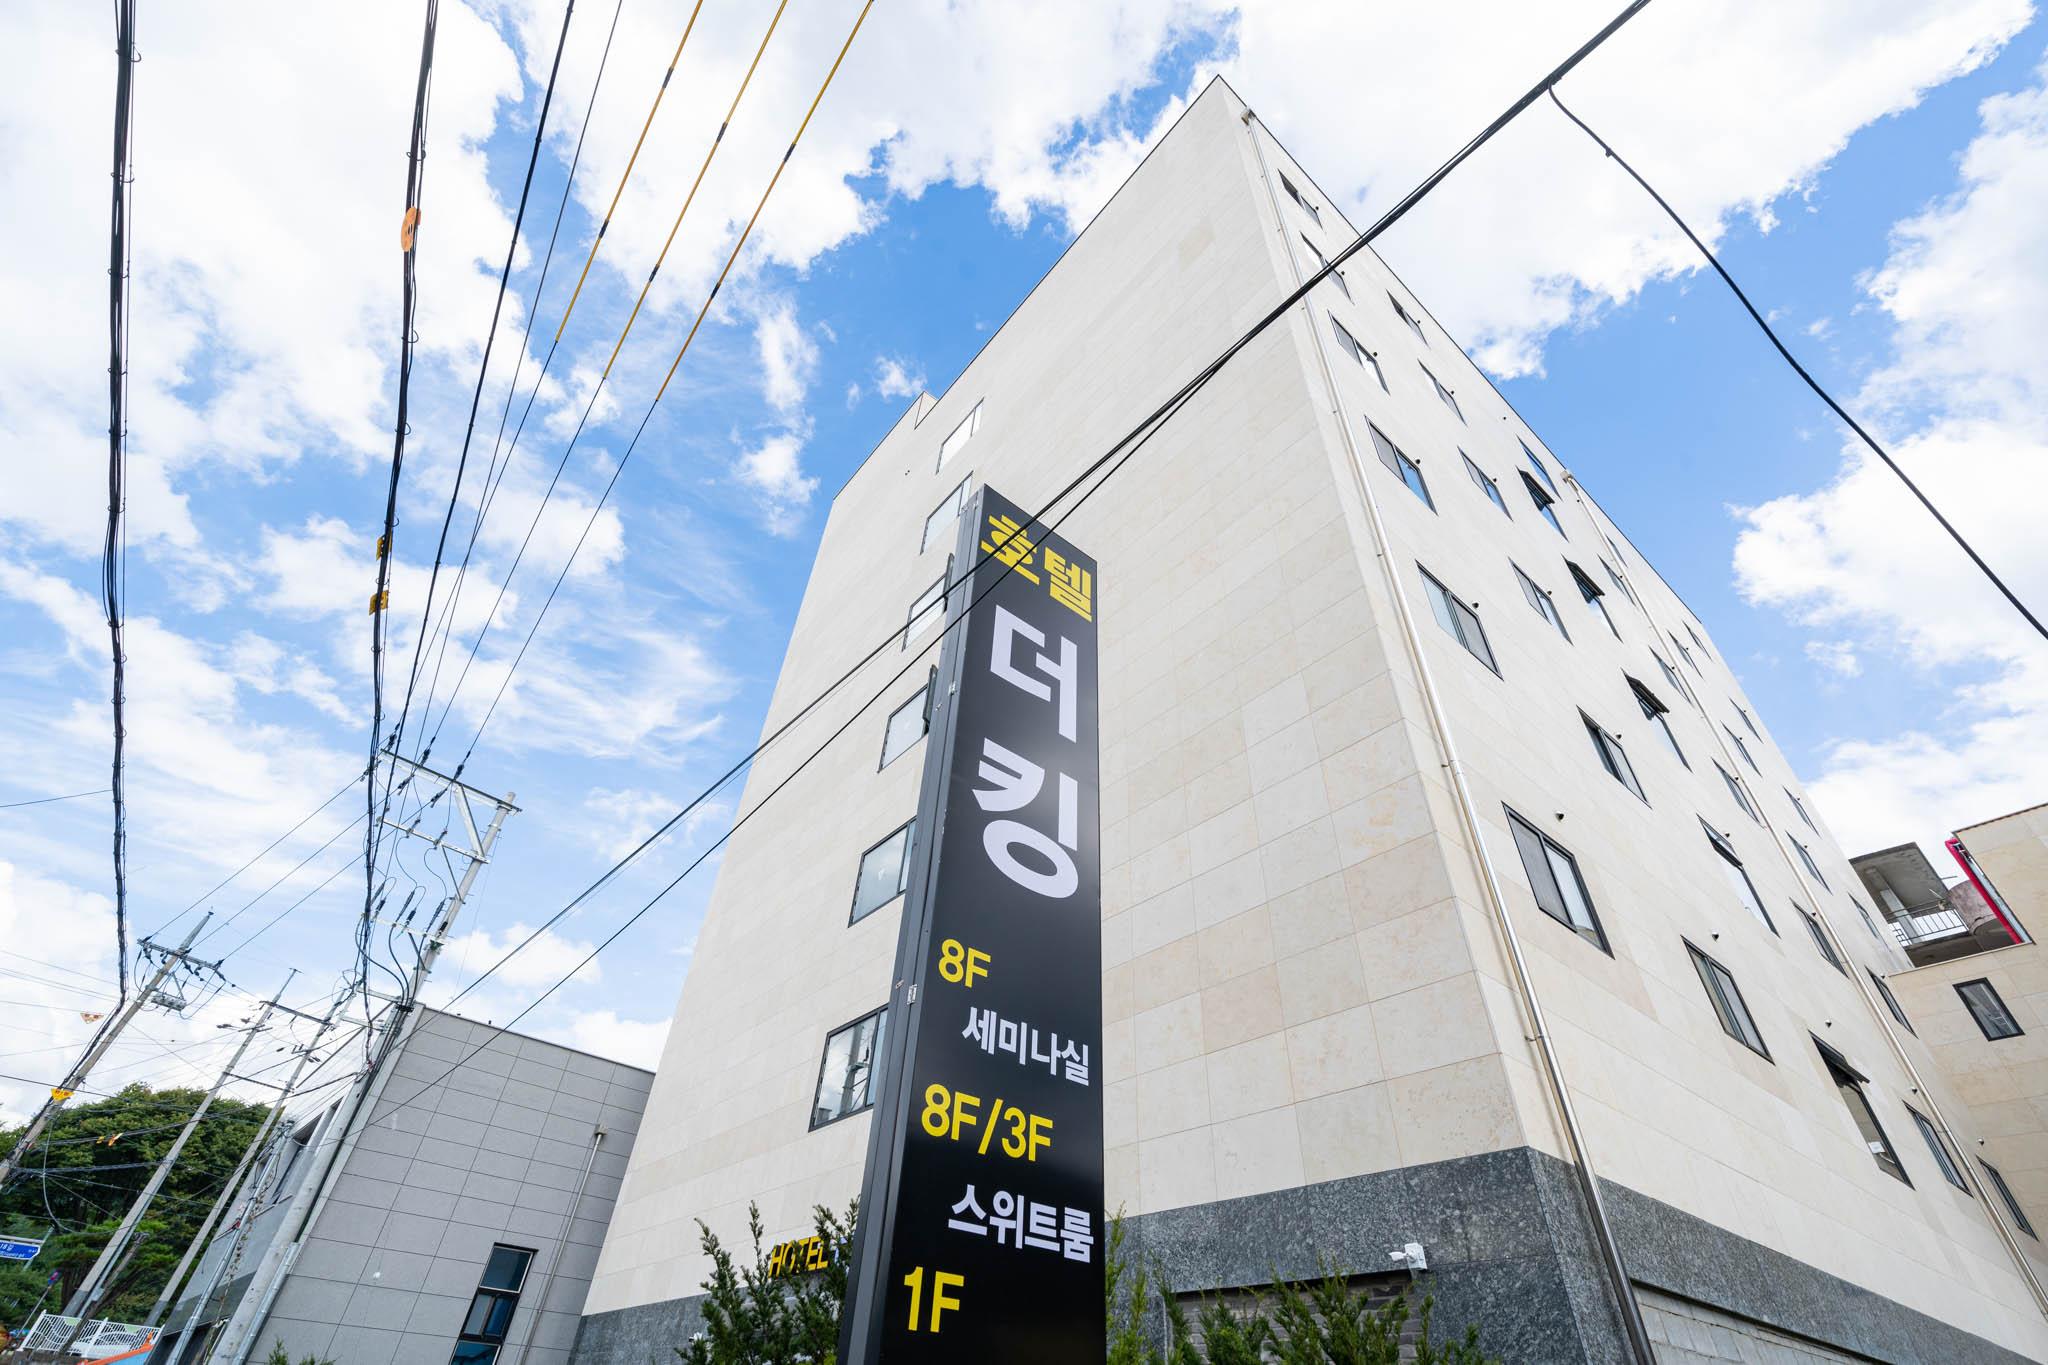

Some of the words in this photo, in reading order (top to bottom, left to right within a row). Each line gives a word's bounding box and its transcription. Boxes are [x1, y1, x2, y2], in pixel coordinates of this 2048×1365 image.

[981, 514, 1092, 622] 호텔
[938, 938, 992, 988] 8F
[961, 1006, 1090, 1087] 세미나실
[921, 1083, 1054, 1162] 8F/3F
[768, 1236, 829, 1280] HOTEL
[948, 1184, 1094, 1263] 스위트룸
[903, 1266, 965, 1333] 1F
